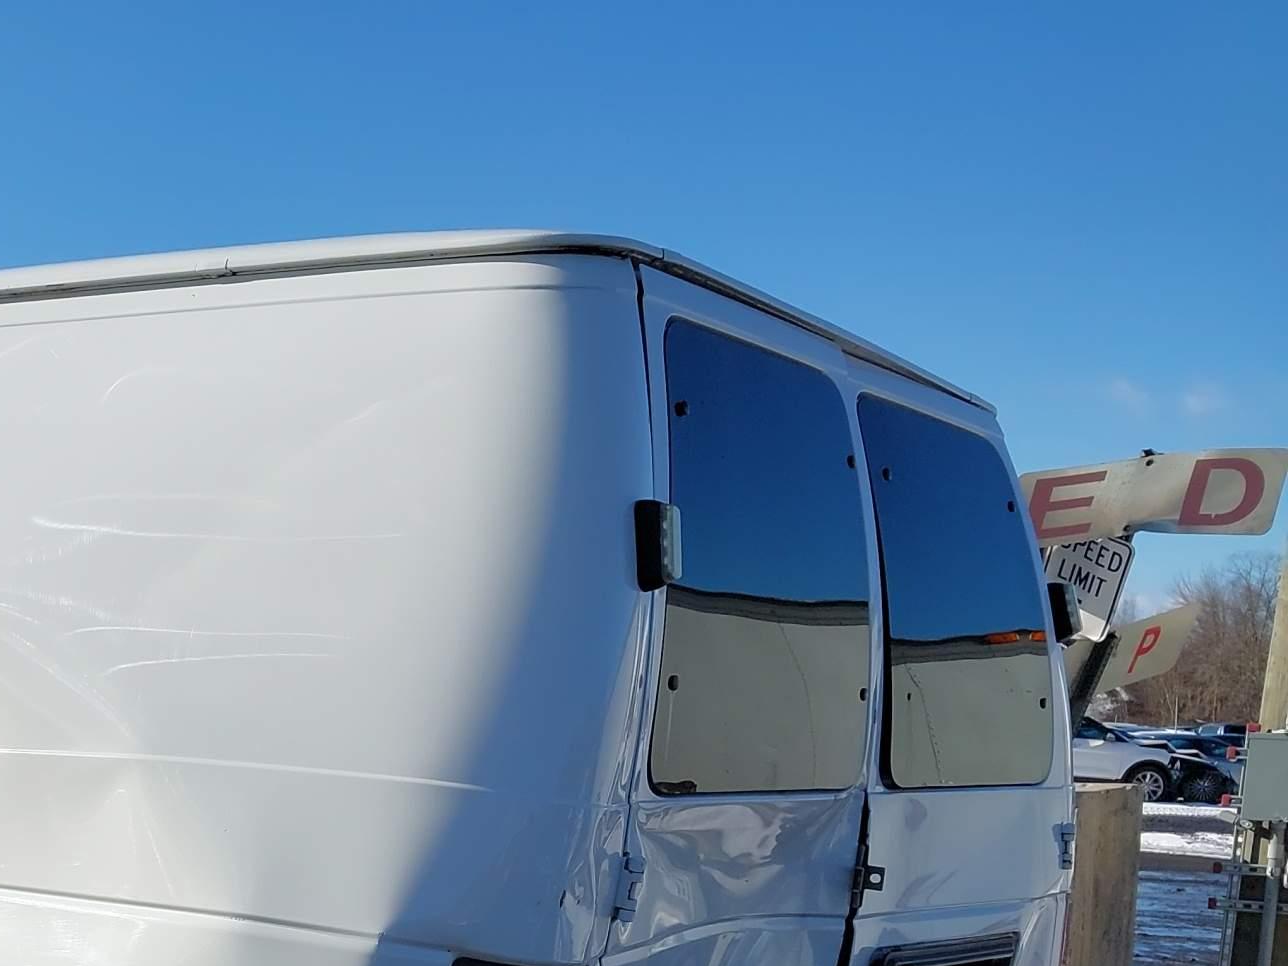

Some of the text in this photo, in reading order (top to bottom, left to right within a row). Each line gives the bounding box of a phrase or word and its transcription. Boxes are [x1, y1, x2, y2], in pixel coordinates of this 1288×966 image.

[1177, 457, 1266, 527] D
[1057, 558, 1108, 598] LIMIT
[1061, 539, 1123, 573] EED
[1127, 626, 1162, 675] P
